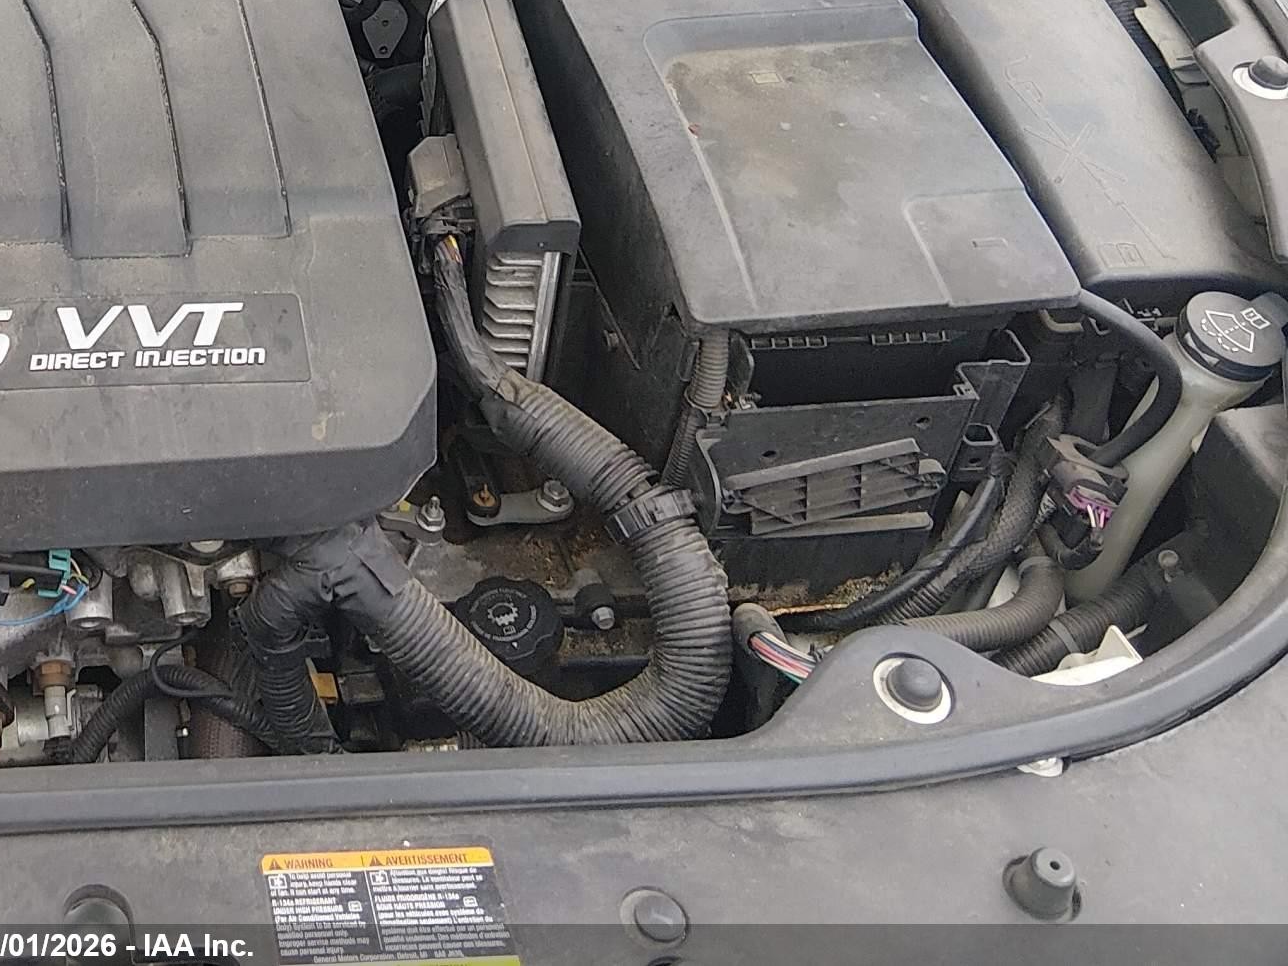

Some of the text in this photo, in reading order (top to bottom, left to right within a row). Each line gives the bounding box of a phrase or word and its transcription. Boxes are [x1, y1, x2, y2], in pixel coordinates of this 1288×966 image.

[56, 302, 244, 350] VVT
[28, 347, 266, 372] DIRECT INJECTION
[283, 858, 333, 869] WARNING
[386, 854, 468, 865] AVERTISSEMENT
